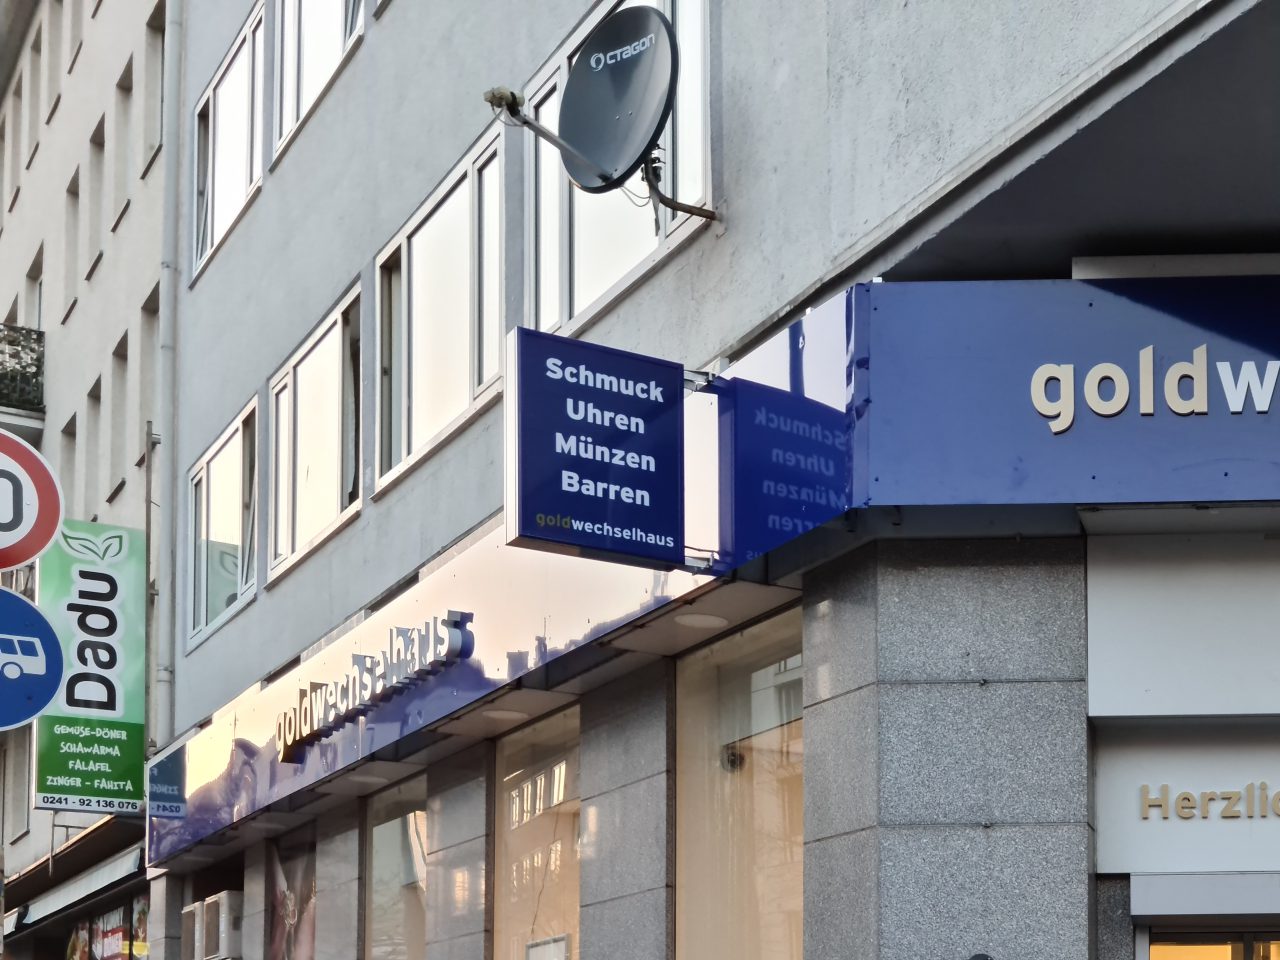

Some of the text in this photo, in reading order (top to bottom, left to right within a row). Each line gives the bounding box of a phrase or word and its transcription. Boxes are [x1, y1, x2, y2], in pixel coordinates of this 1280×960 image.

[545, 357, 664, 403] Schmuck
[566, 398, 646, 434] Uhren
[554, 432, 656, 472] Münzen
[561, 470, 651, 507] Barren
[535, 511, 675, 548] goldwechselhaus
[65, 569, 119, 711] Dadu
[69, 759, 112, 772] FALAFEL
[42, 796, 68, 805] 0241
[78, 798, 92, 807] 92
[96, 799, 115, 808] 136
[118, 801, 138, 810] 076
